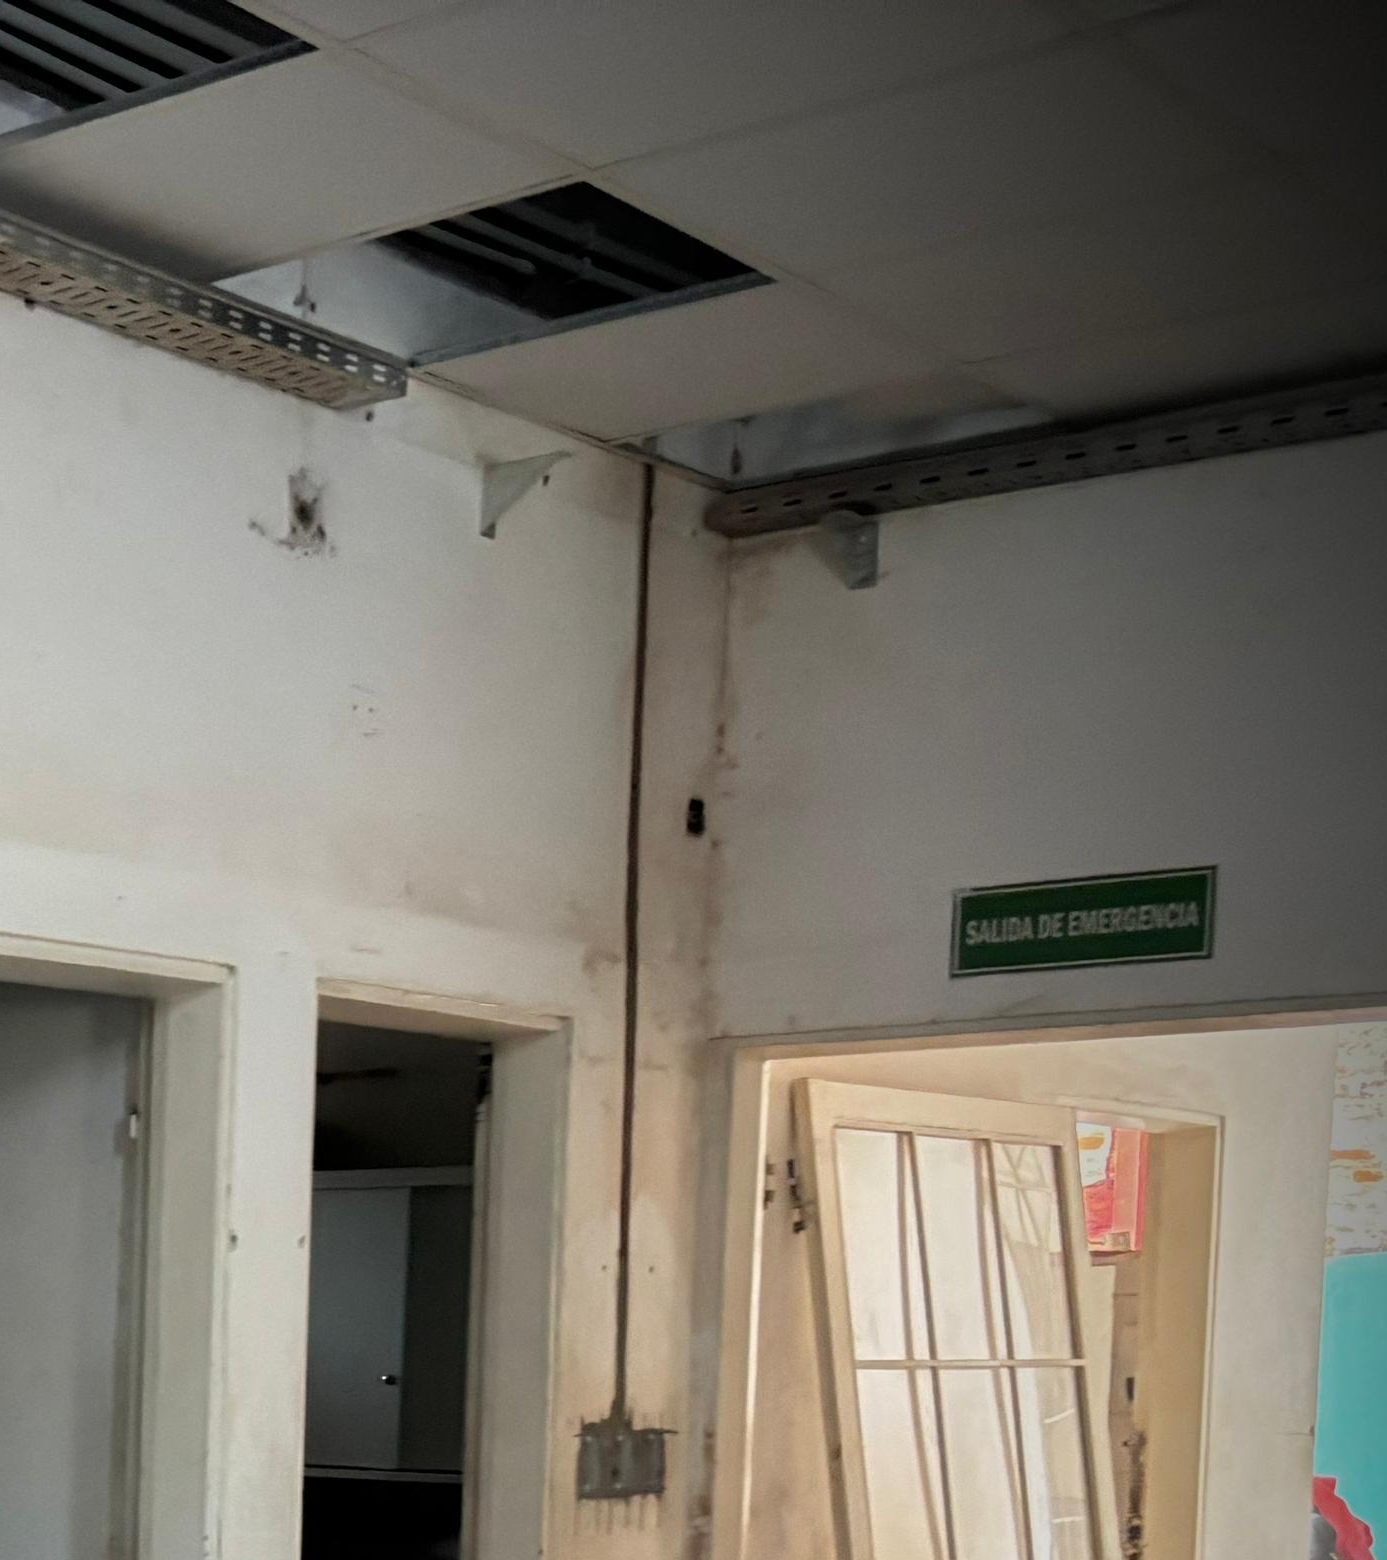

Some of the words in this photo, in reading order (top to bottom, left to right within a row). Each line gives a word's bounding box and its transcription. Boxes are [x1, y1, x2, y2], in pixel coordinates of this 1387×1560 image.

[965, 917, 1033, 944] SALIDA
[1038, 913, 1064, 939] DE
[1068, 902, 1199, 936] EMERGENCIA
